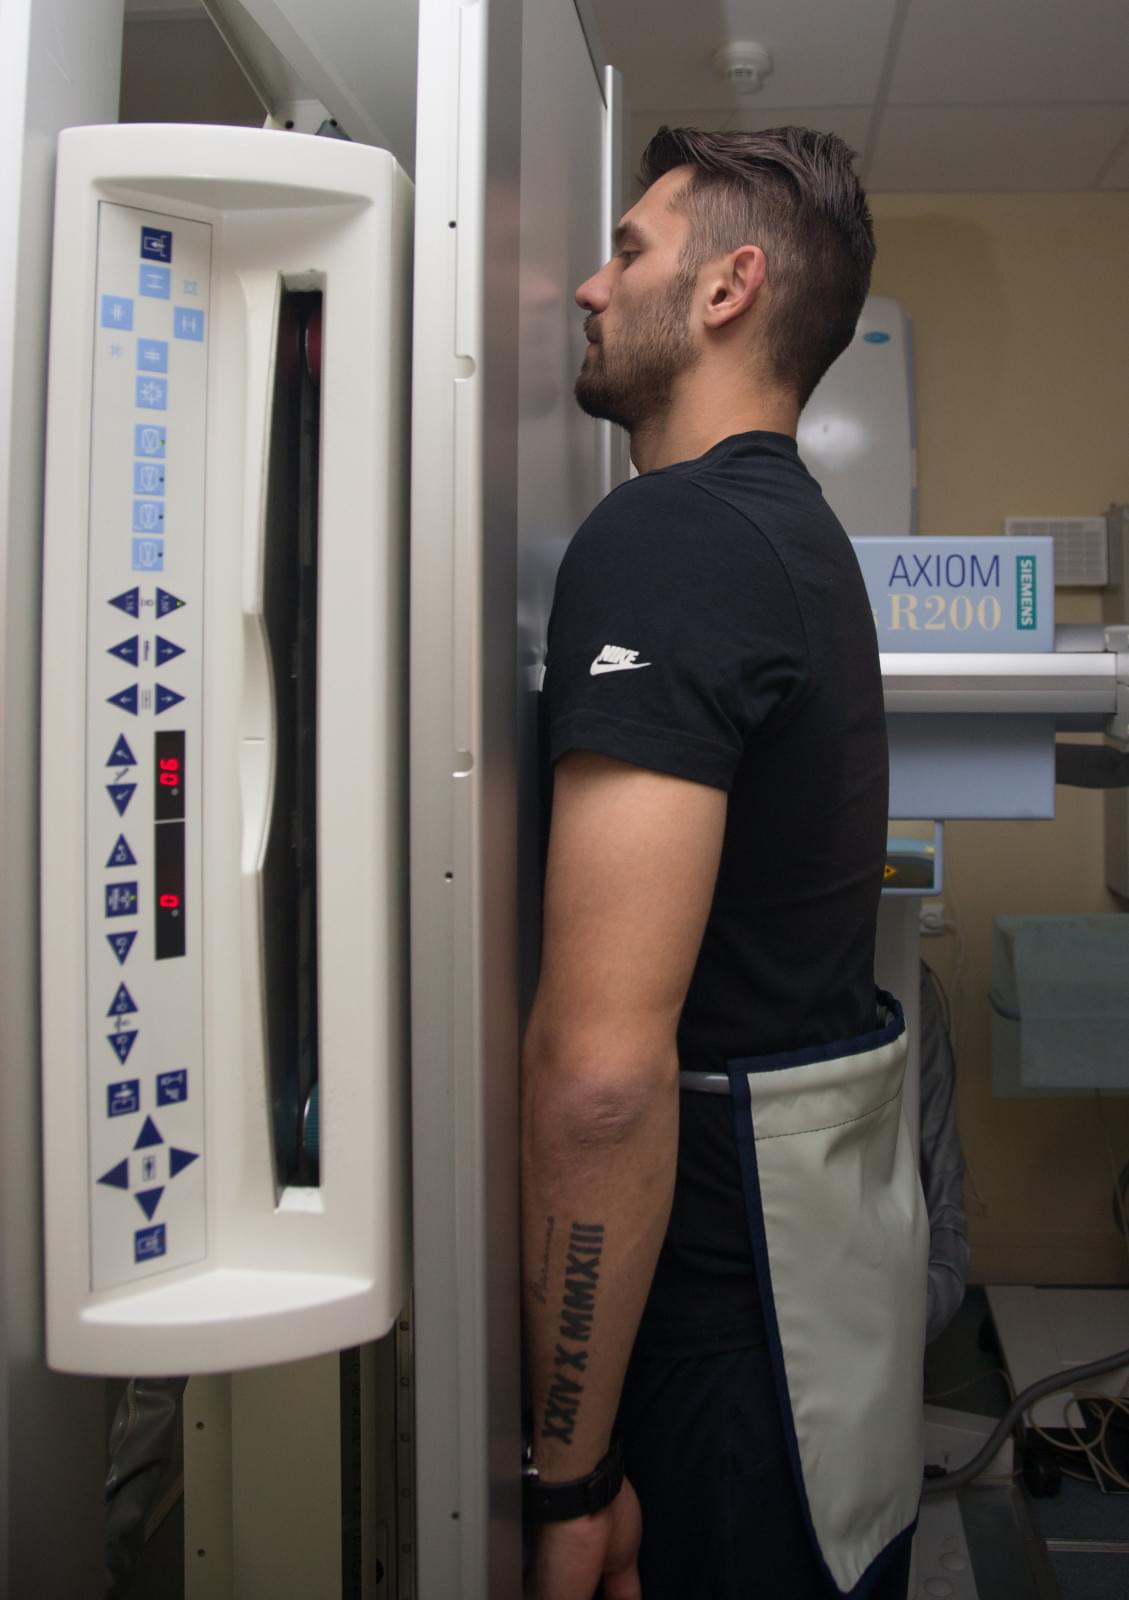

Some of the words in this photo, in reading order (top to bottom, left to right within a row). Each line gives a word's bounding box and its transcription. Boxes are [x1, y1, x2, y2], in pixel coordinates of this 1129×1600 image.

[888, 554, 1000, 588] AXIOM
[1020, 559, 1034, 626] SIEMENS
[888, 593, 1001, 631] R200
[599, 644, 640, 664] NIKE
[559, 1221, 604, 1342] MMXIII
[554, 1344, 588, 1372] X
[541, 1374, 584, 1445] XXIV
